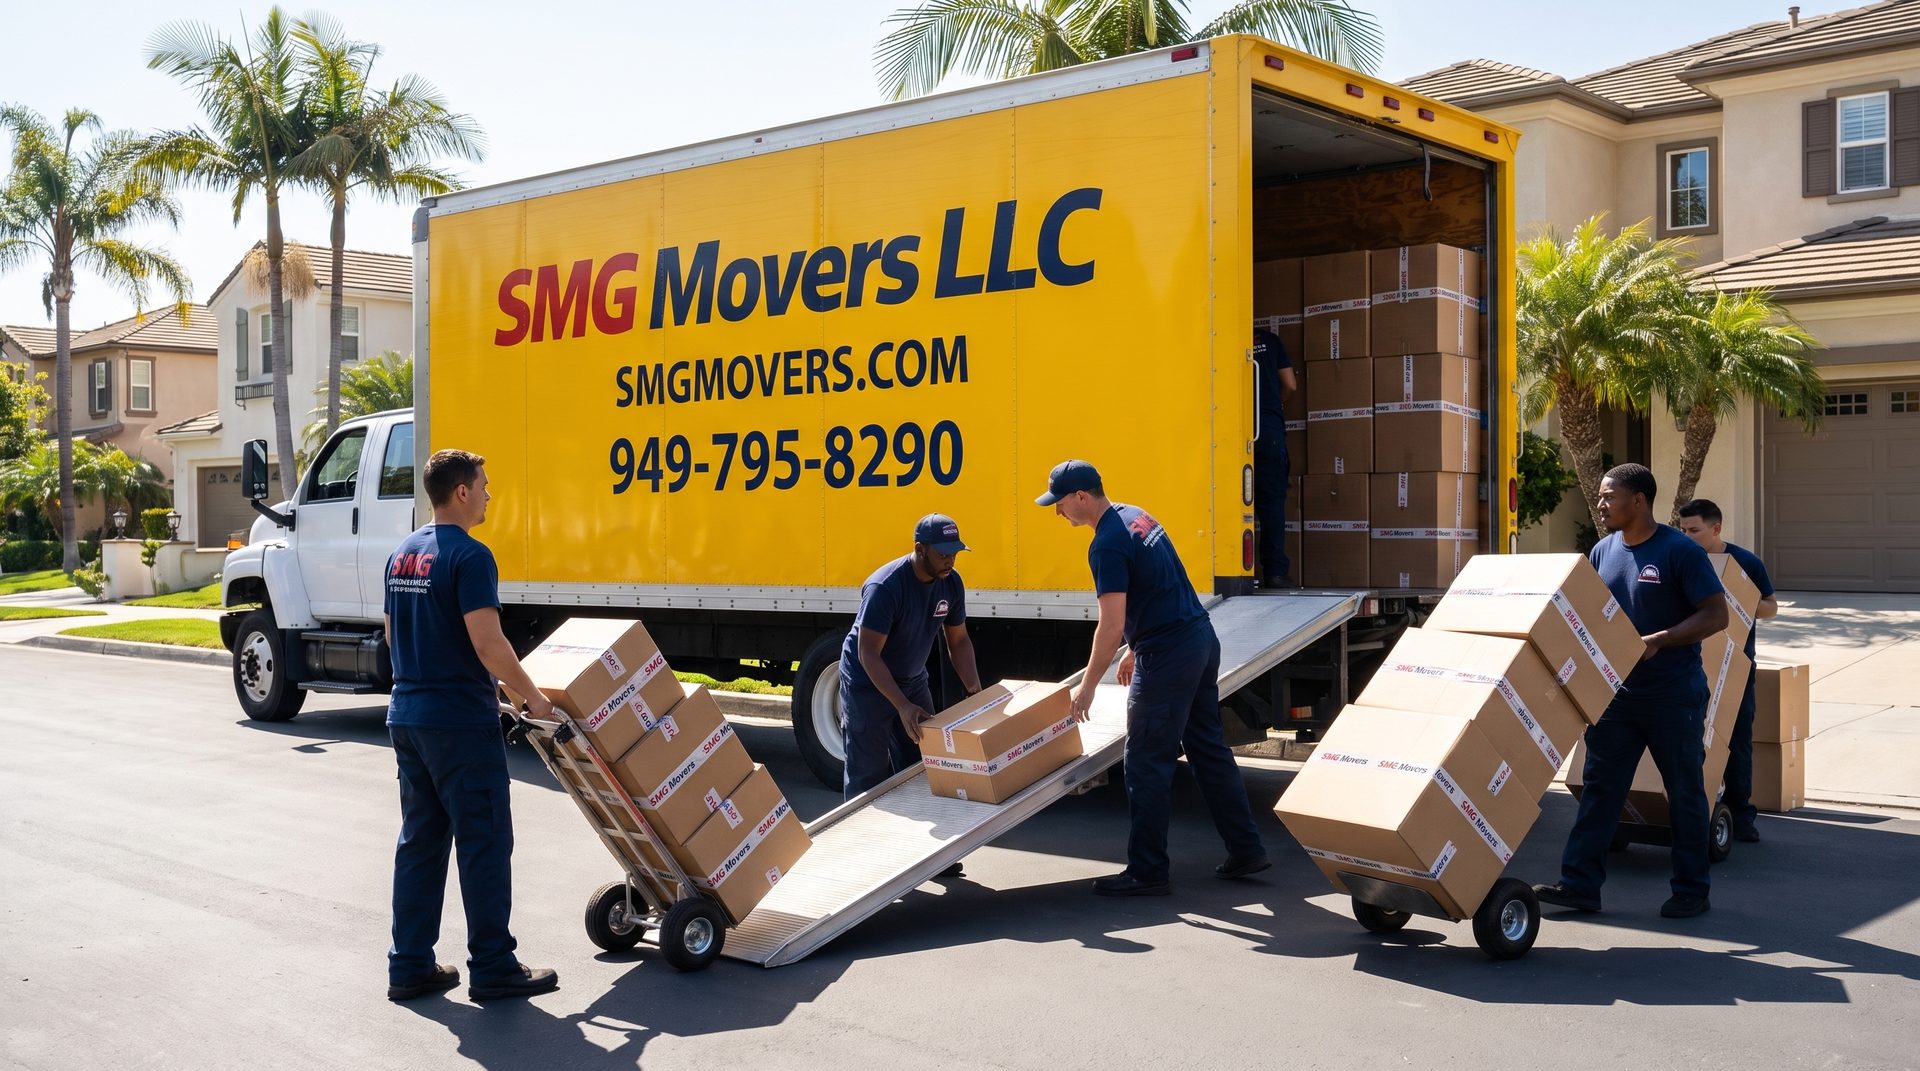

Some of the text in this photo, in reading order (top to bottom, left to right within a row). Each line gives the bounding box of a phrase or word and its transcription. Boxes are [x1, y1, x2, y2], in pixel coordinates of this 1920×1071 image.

[494, 187, 1104, 347] SMG Movers LLC
[616, 334, 969, 408] SMGMOVERS.COM
[610, 420, 964, 494] 949-795-8290
[391, 552, 433, 577] SMG
[589, 707, 609, 728] SMG
[645, 655, 663, 676] SMG
[650, 785, 669, 806] SMG
[668, 761, 695, 789] Movers
[703, 733, 720, 754] SMG
[925, 757, 940, 766] SMG
[941, 760, 963, 769] Movers
[1007, 747, 1022, 761] SMG
[1321, 752, 1340, 761] SMG
[707, 868, 726, 888] SMG
[725, 843, 751, 872] Movers
[758, 814, 776, 836] SMG
